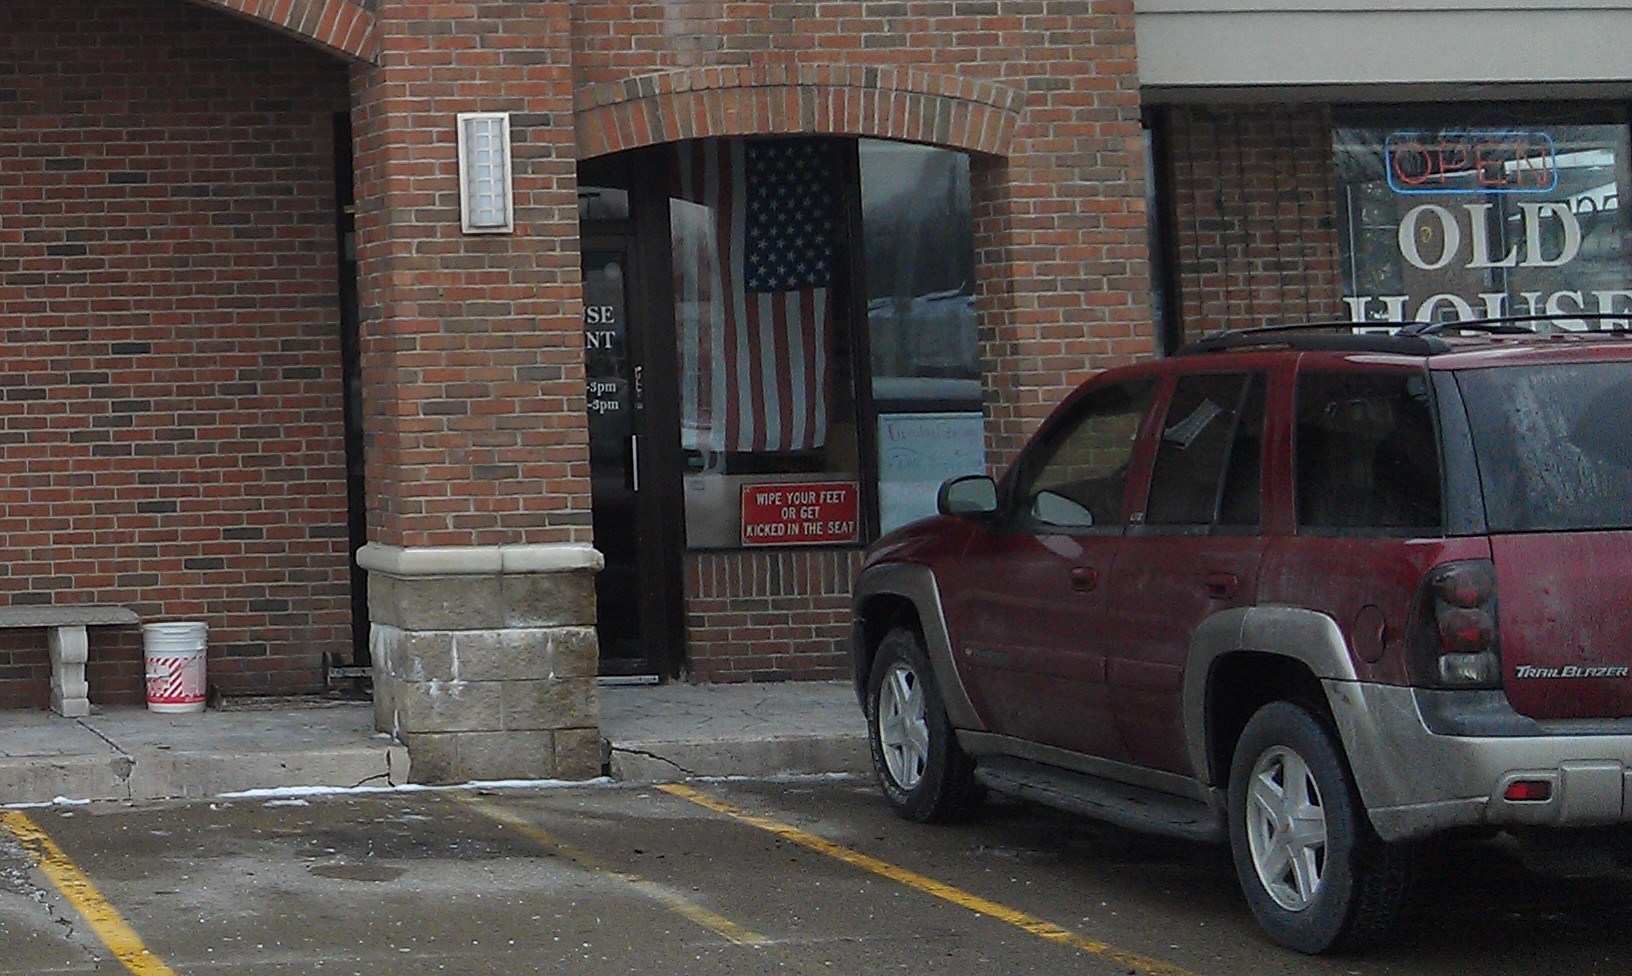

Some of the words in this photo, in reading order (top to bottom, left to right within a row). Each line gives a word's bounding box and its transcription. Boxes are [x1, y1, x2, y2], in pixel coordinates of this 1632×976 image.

[1393, 142, 1549, 185] OPEN
[1398, 202, 1582, 270] OLD
[583, 306, 616, 324] SE
[756, 492, 783, 506] WIPE
[786, 491, 816, 505] YOUR
[819, 490, 846, 504] FEET
[781, 507, 796, 520] OR
[800, 506, 820, 519] GET
[746, 524, 785, 537] KICKED
[787, 523, 799, 535] IN
[803, 522, 823, 535] THE
[828, 521, 855, 534] SEAT
